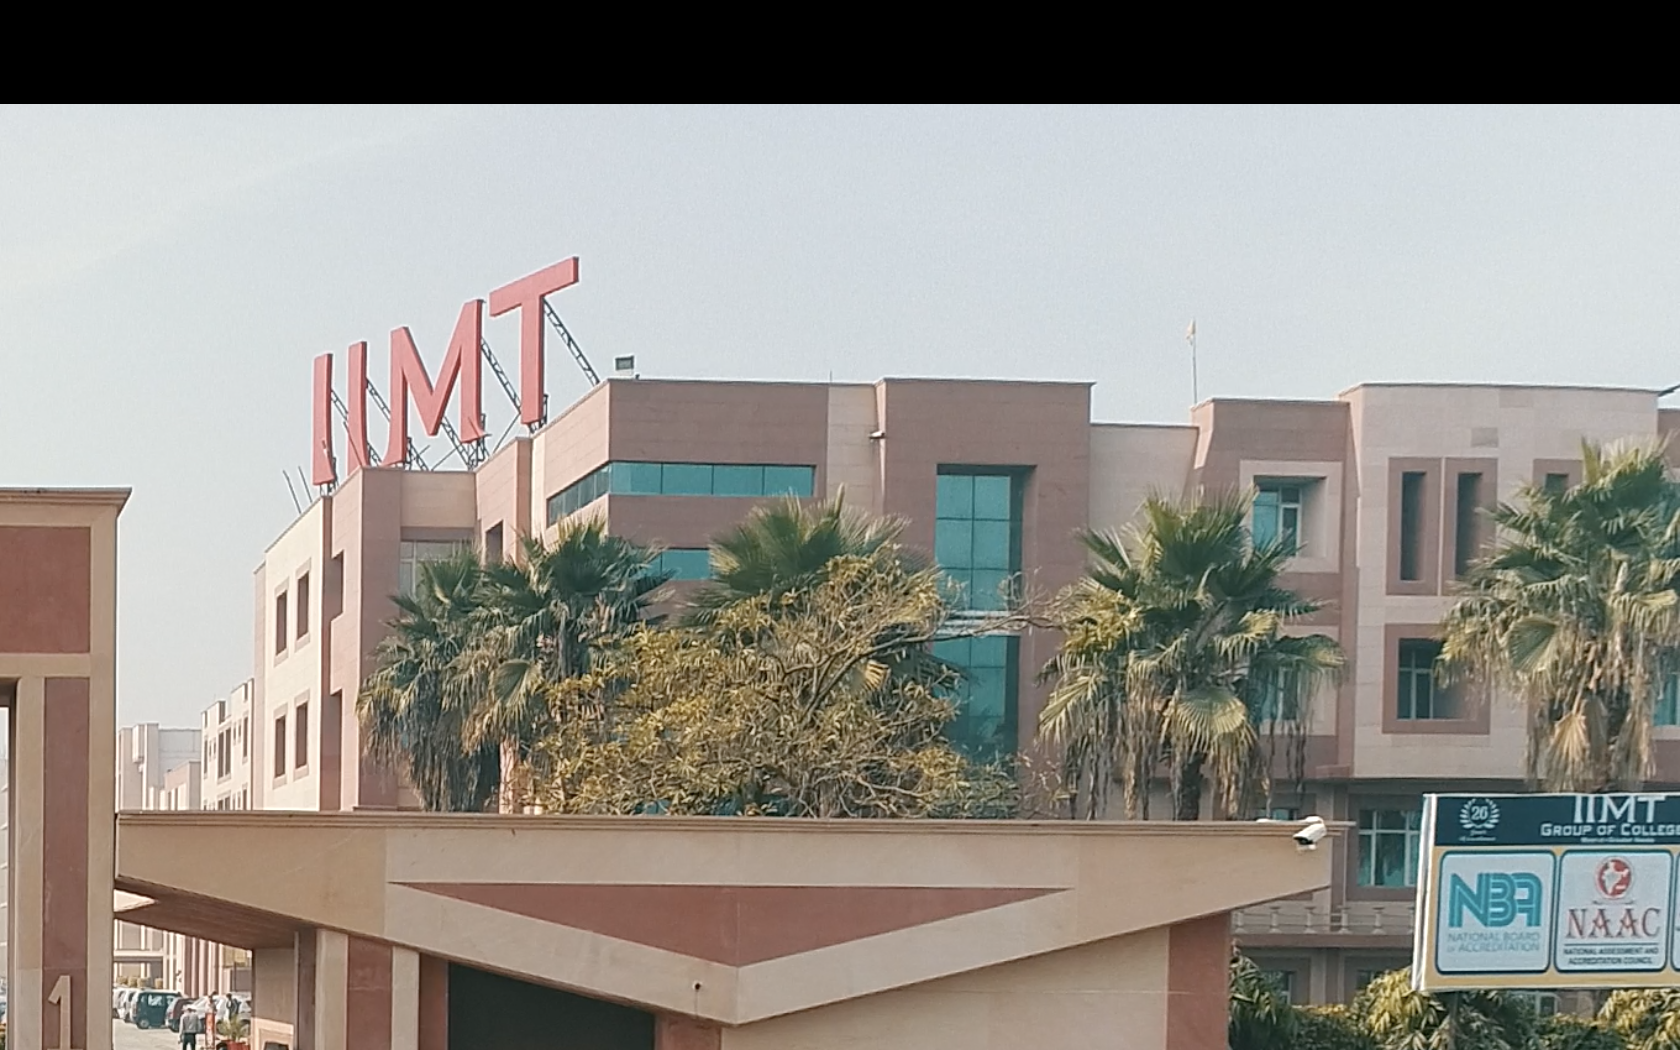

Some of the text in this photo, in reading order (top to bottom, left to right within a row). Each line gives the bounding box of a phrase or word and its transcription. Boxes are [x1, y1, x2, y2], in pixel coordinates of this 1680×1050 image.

[313, 257, 579, 486] IIMT
[1574, 795, 1666, 823] IIMT
[1448, 872, 1542, 927] NBA
[1565, 906, 1662, 940] NAAC
